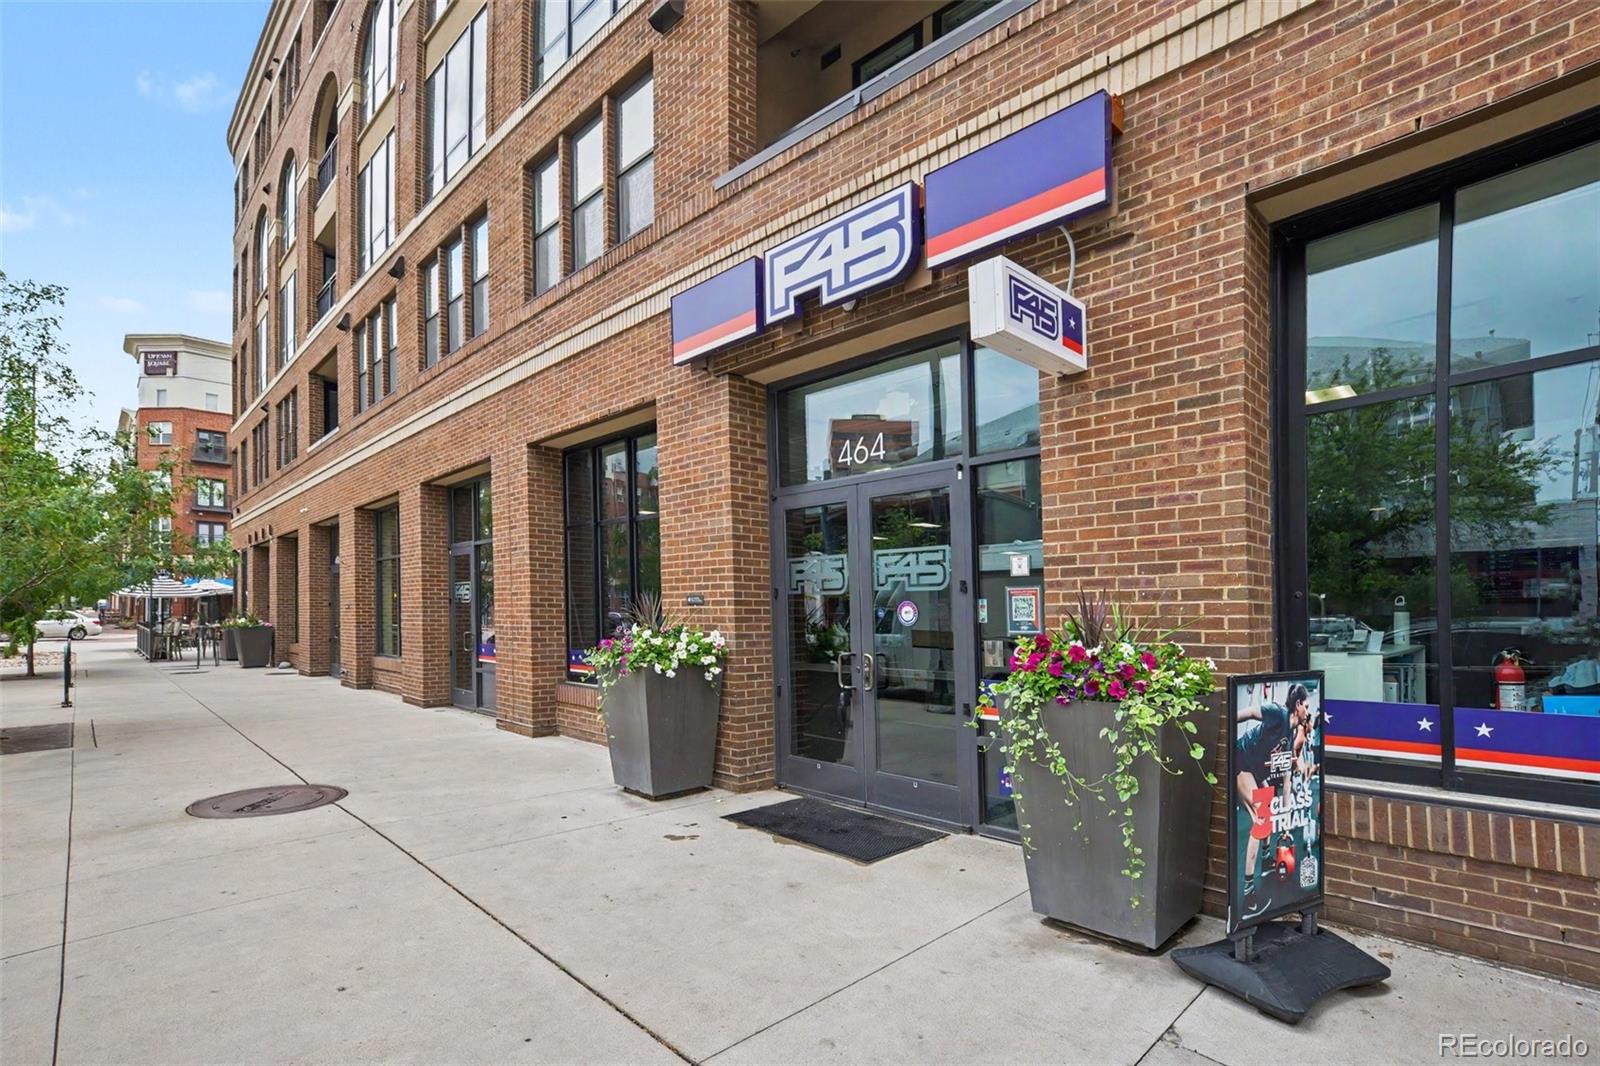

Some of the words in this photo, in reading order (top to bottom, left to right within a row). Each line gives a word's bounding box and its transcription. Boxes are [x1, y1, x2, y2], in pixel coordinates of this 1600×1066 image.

[768, 190, 907, 318] F45
[1008, 274, 1059, 341] F45
[838, 432, 886, 466] 464
[788, 555, 849, 595] F45
[874, 545, 951, 592] F45
[1270, 751, 1293, 773] F45
[1270, 790, 1313, 815] CLASS
[1269, 809, 1309, 834] TRIAL
